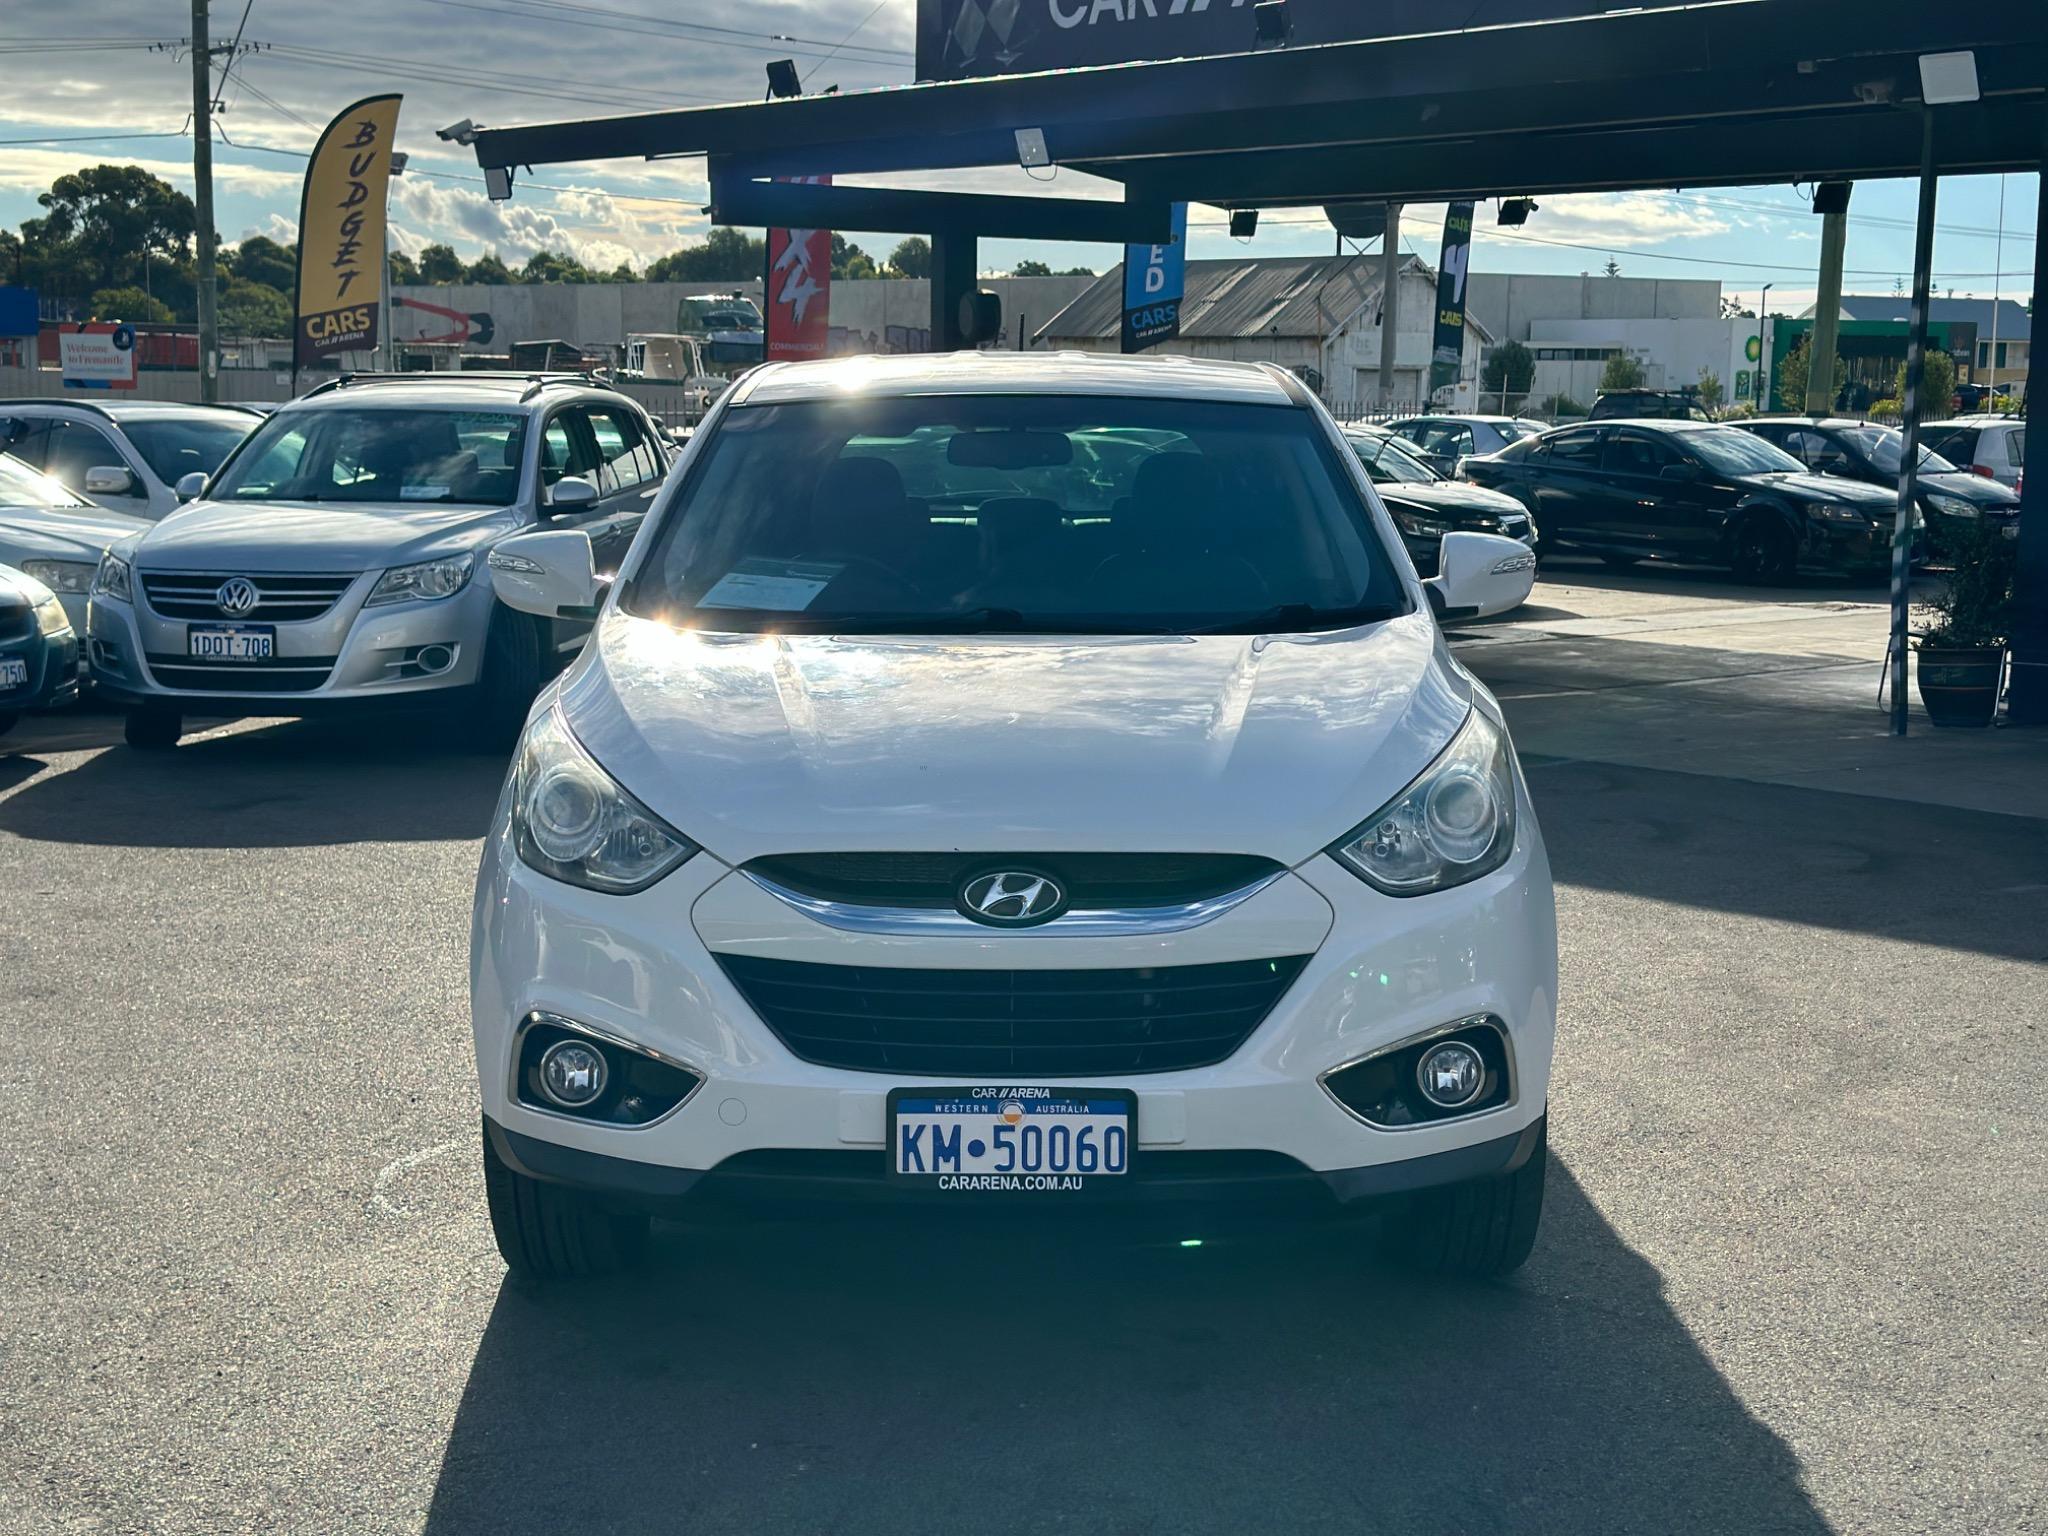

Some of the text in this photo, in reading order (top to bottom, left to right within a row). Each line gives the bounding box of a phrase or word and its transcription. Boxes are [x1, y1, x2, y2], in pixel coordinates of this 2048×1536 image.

[330, 119, 377, 300] BUDGET
[306, 307, 371, 339] CARS
[1131, 305, 1176, 329] CARS
[67, 343, 108, 353] Welcome
[971, 1088, 997, 1098] CAR
[934, 1104, 1090, 1113] WESTERN AUSTRALIA
[938, 1175, 1083, 1191] CARARENA.COM.AU
